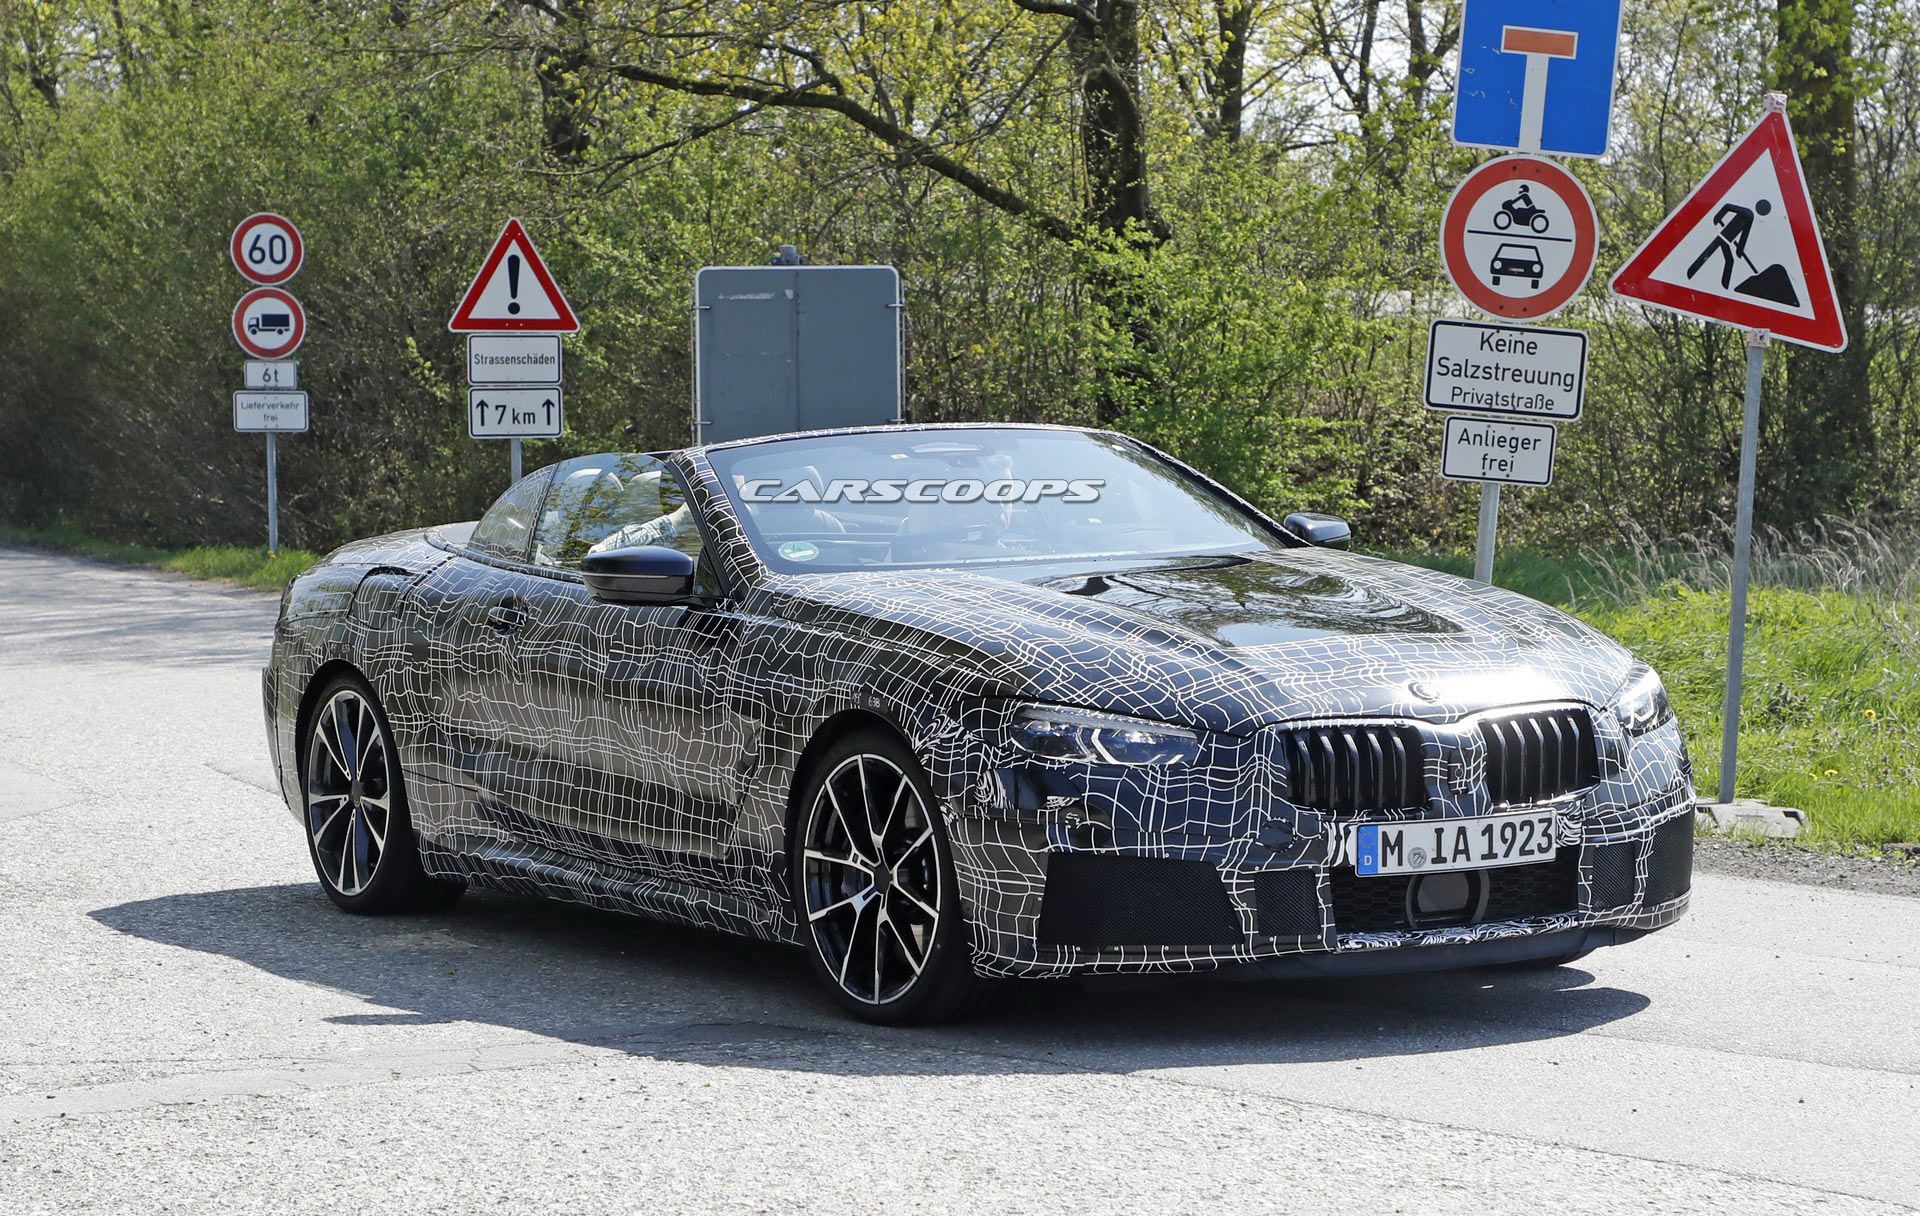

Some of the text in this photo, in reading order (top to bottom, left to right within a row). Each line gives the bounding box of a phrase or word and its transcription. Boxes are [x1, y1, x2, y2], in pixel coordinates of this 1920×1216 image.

[248, 233, 287, 265] 60
[1479, 331, 1538, 356] Keine
[474, 352, 556, 365] Strassenschäden
[262, 367, 279, 383] 6t
[1436, 356, 1575, 393] Salzstreuung
[240, 401, 300, 410] Lieferverkehr
[1451, 386, 1555, 411] Privatstraße
[263, 413, 278, 422] frei
[495, 404, 536, 425] 7 km
[1457, 427, 1541, 454] Anlieger
[1481, 453, 1515, 473] frei
[1381, 816, 1554, 868] M IA 1923
[1364, 855, 1372, 866] D
